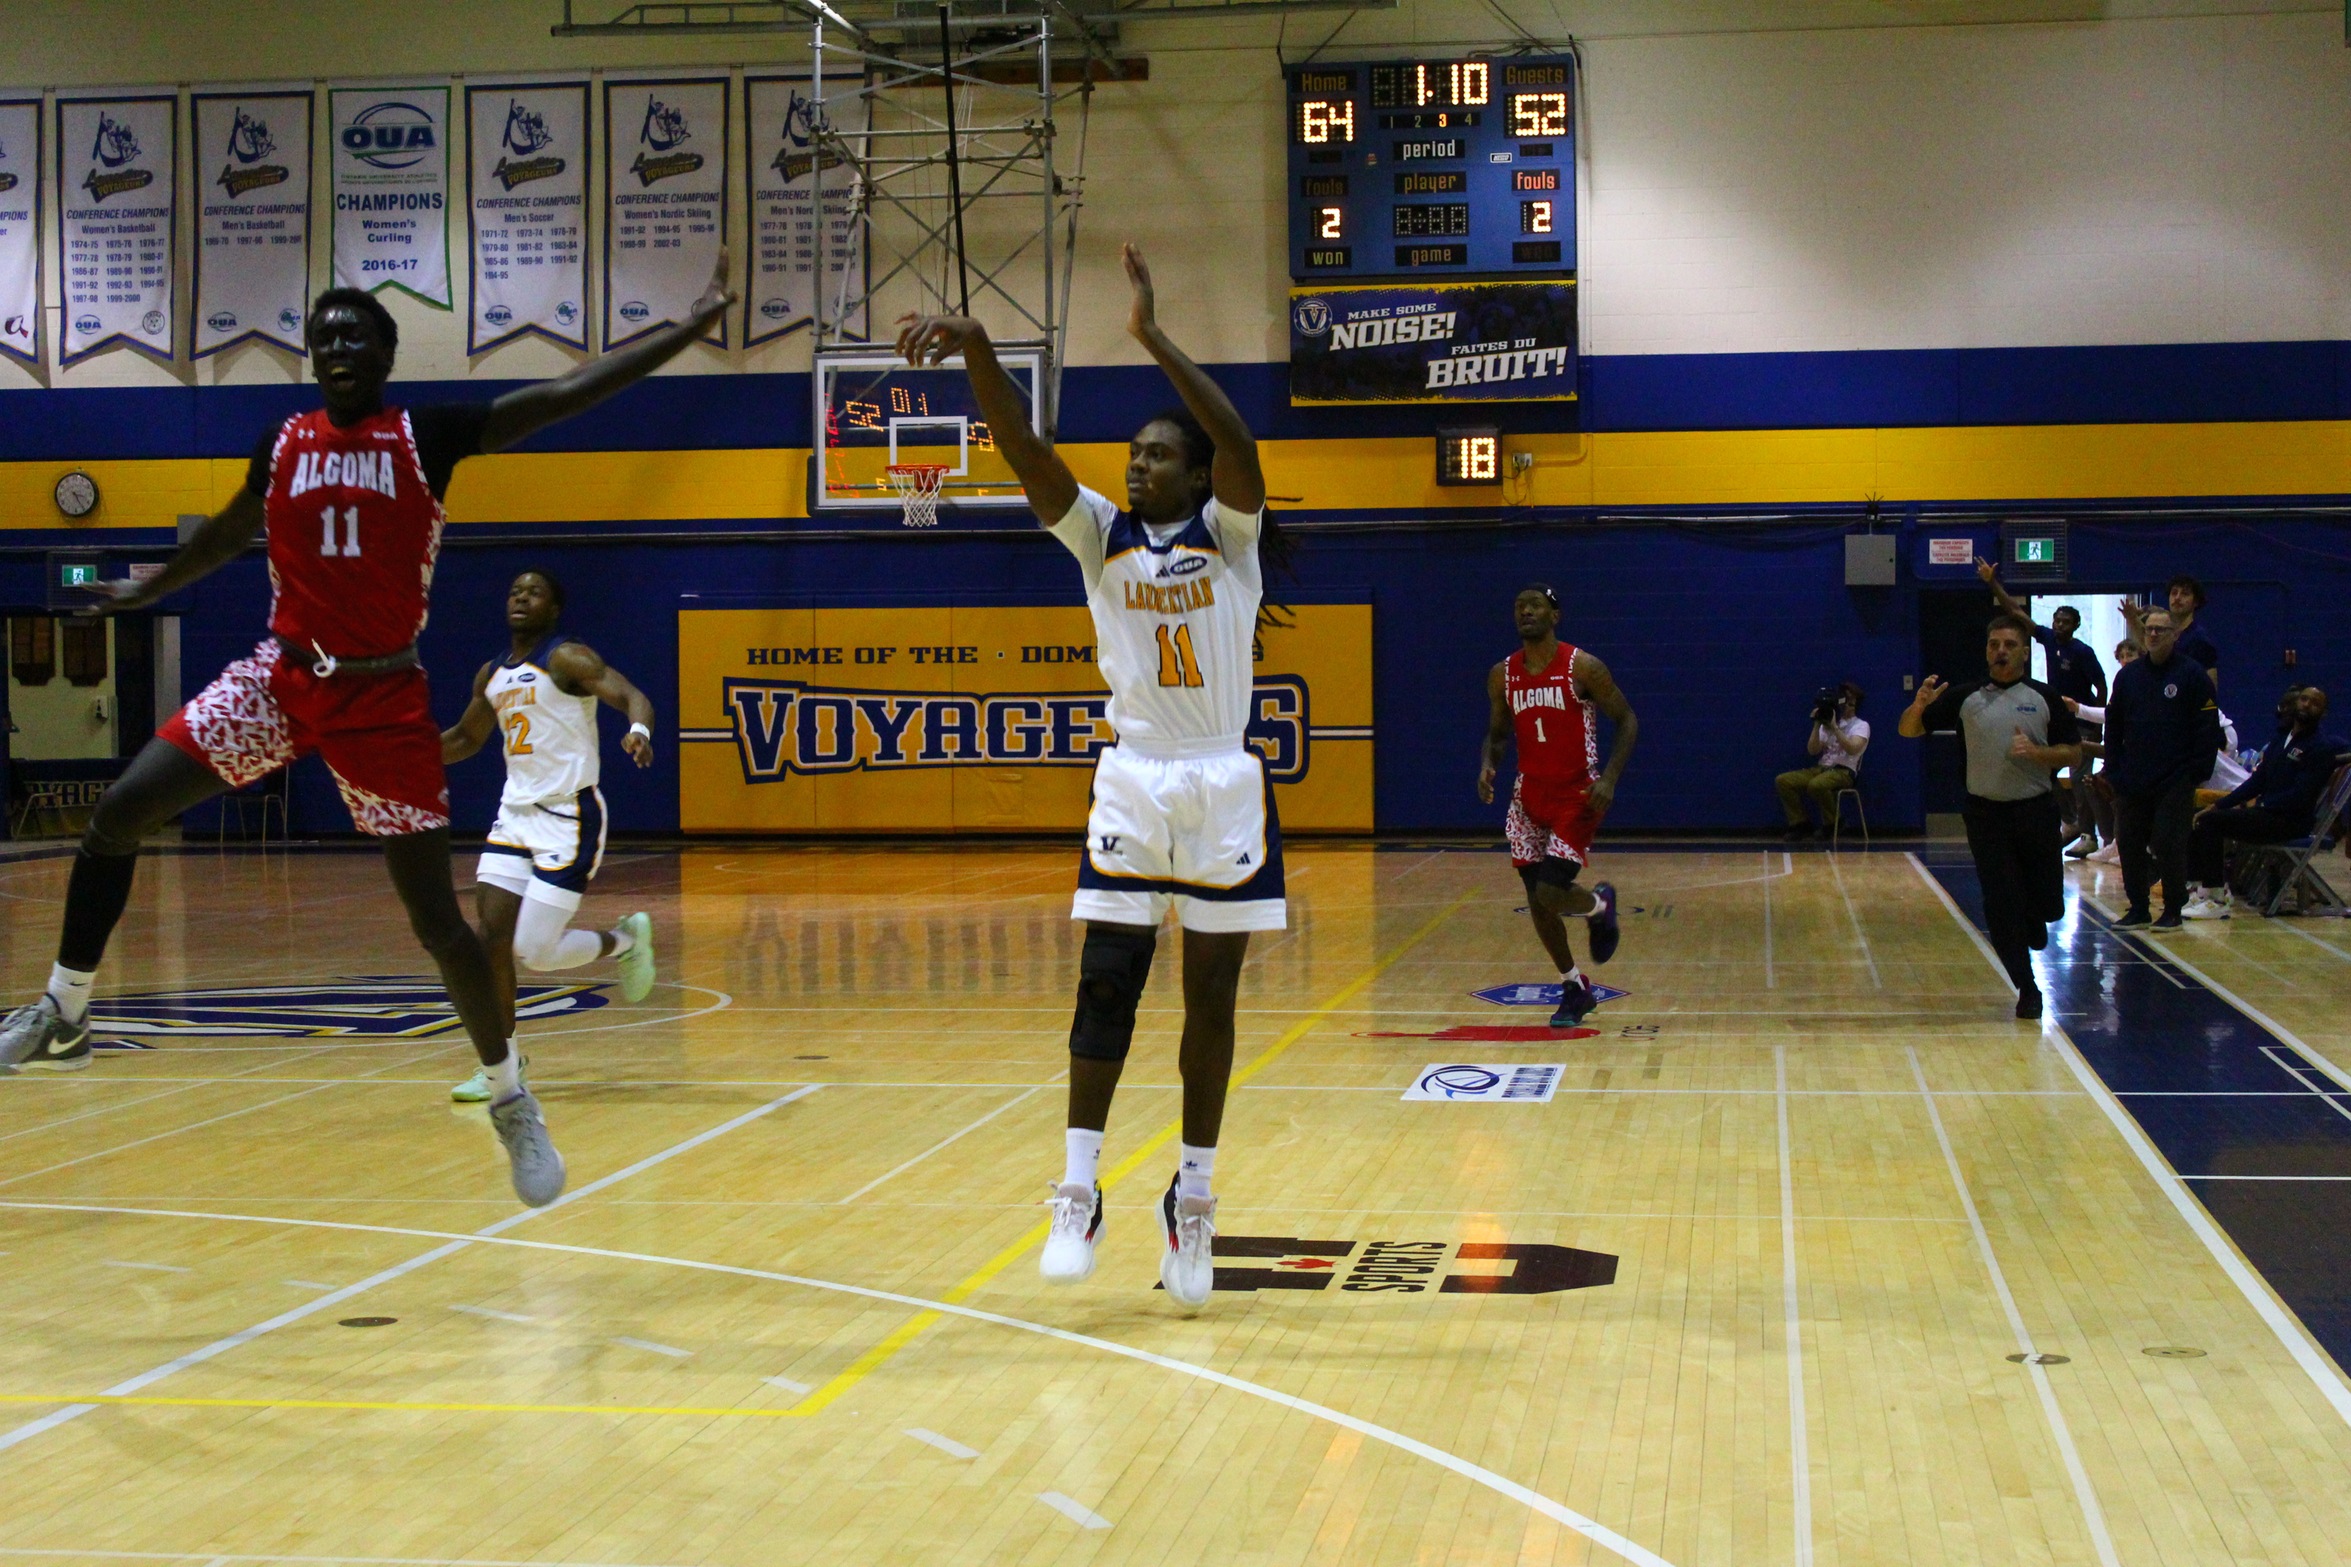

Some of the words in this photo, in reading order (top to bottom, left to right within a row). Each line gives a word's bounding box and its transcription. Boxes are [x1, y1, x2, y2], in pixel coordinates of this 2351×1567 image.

[1302, 73, 1347, 92] Home
[1506, 65, 1564, 84] Guests
[1304, 100, 1353, 143] 64
[1438, 113, 1447, 127] 3
[1514, 93, 1566, 136] 52
[342, 125, 437, 150] OUA
[1402, 139, 1456, 160] period
[1404, 172, 1457, 194] player
[1517, 171, 1555, 190] fouls
[336, 193, 443, 211] CHAMPIONS
[476, 198, 531, 209] CONFERENCE
[532, 195, 582, 207] CHAMPIONS
[615, 194, 669, 205] CONFERENCE
[671, 192, 720, 203] CHAMPIONS
[756, 189, 811, 200] CONFERENCE
[67, 209, 119, 219] CONFERENCE
[204, 205, 256, 216] CONFERENCE
[257, 204, 305, 215] CHAMPIONS
[504, 213, 527, 223] Men's
[529, 213, 554, 222] Soccer
[624, 210, 659, 219] Women's
[660, 209, 685, 218] Nordic
[687, 208, 711, 219] Skiing
[770, 206, 794, 215] Men's
[1532, 201, 1551, 232] 2
[82, 224, 116, 234] Women's
[117, 223, 155, 233] Basketball
[222, 221, 244, 230] Men's
[247, 220, 285, 230] Basketball
[362, 219, 417, 229] Women's
[1322, 208, 1341, 238] 2
[368, 233, 412, 244] Curling
[362, 259, 418, 271] 2016-17
[1313, 250, 1344, 265] won
[1411, 248, 1451, 267] game
[484, 311, 513, 320] OUA
[761, 305, 791, 313] OUA
[1347, 307, 1390, 321] MAKE
[1396, 302, 1437, 315] SOME
[75, 321, 102, 329] OUA
[1329, 311, 1457, 351] NOISE!
[1451, 340, 1508, 355] FAITES
[1514, 338, 1536, 349] DU
[1425, 346, 1568, 390] BRUIT!
[1460, 437, 1495, 479] 18
[289, 450, 397, 500] ALGOMA
[320, 505, 362, 557] 11
[1173, 557, 1206, 574] OUA
[746, 647, 843, 665] HOME
[854, 646, 897, 664] OF
[909, 646, 978, 664] THE
[1155, 623, 1205, 687] 11
[1513, 686, 1566, 716] ALGOMA
[1535, 717, 1547, 742] 1
[1100, 835, 1121, 851] V
[1341, 1241, 1447, 1293] SPORTS
